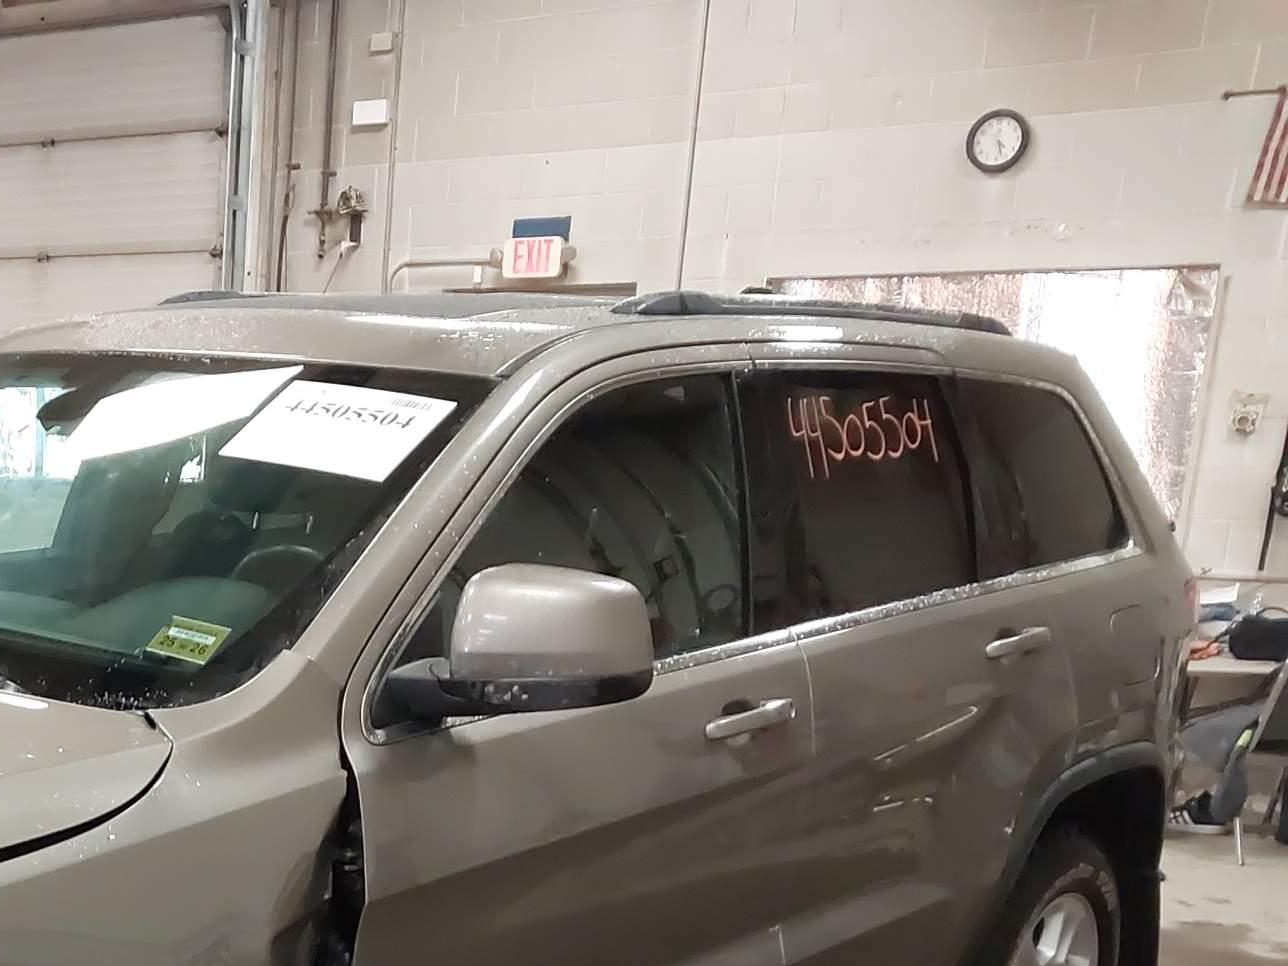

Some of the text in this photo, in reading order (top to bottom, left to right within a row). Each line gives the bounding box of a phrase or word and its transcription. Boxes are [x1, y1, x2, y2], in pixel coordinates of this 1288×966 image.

[512, 239, 554, 274] EXIT
[285, 399, 417, 429] 44505504
[786, 396, 939, 480] 44505504
